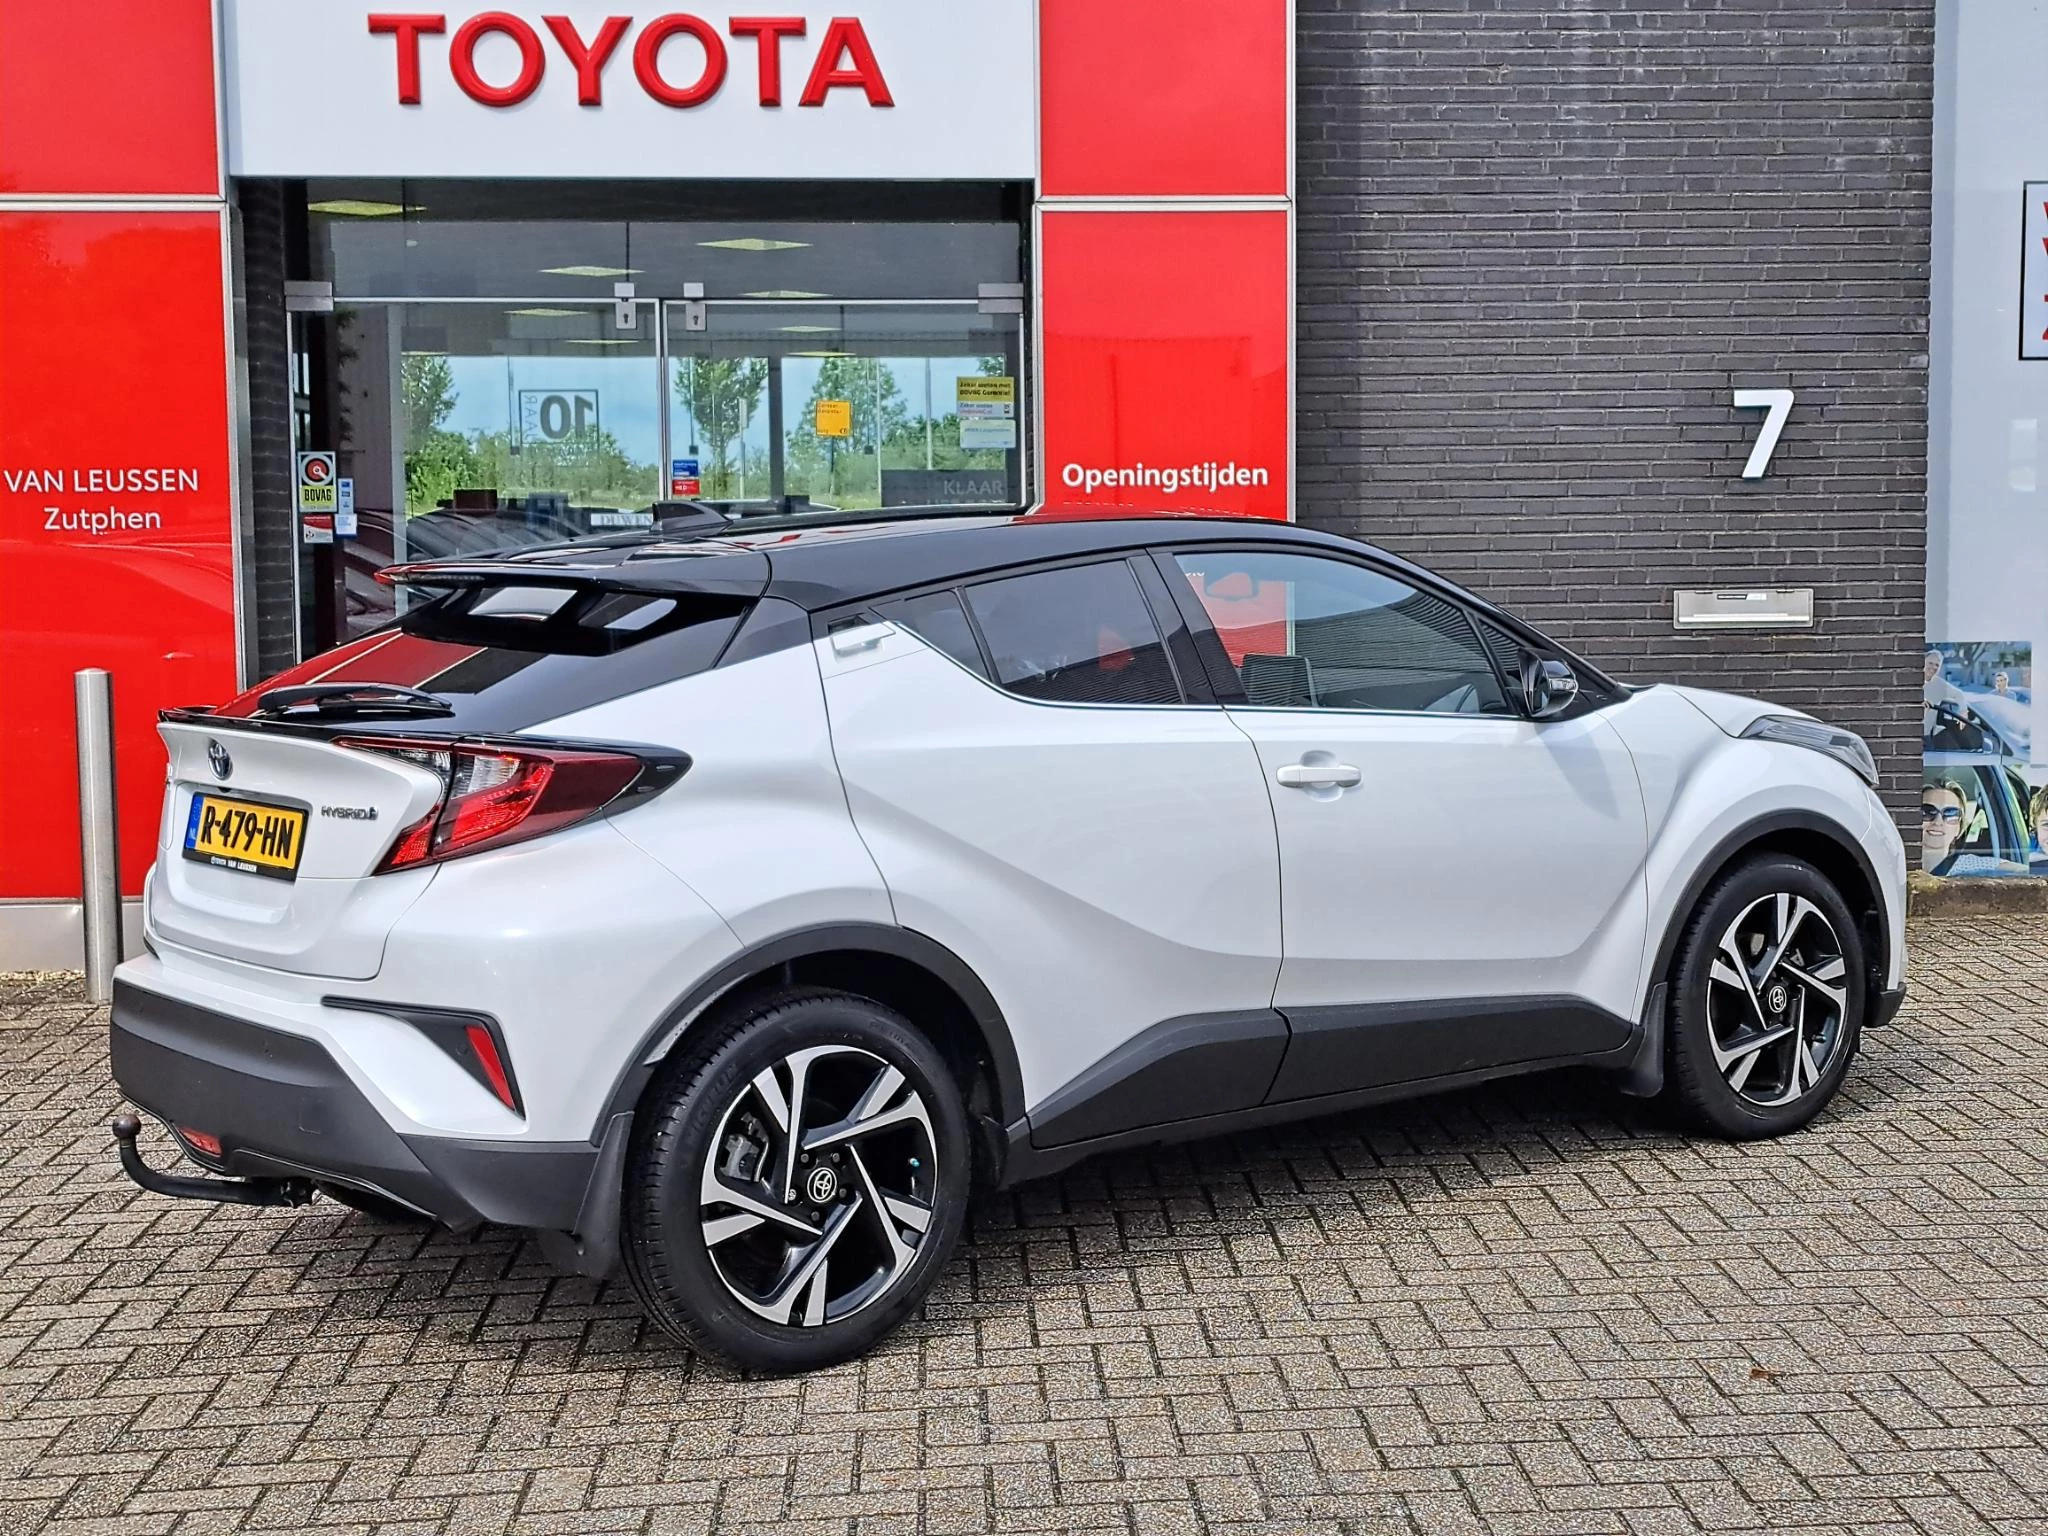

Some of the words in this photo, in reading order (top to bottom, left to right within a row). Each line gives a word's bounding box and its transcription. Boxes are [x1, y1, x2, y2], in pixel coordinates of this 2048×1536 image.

[368, 11, 895, 108] TOYOTA
[1734, 390, 1794, 478] 7
[3, 469, 64, 493] VAN
[73, 469, 199, 492] LEUSSEN
[943, 480, 1004, 496] KLAAR
[1062, 462, 1268, 493] Openingstijden
[304, 488, 332, 502] BOVAG
[44, 506, 161, 535] Zutphen
[321, 806, 367, 820] HYBRID
[200, 805, 295, 860] R-479-HN
